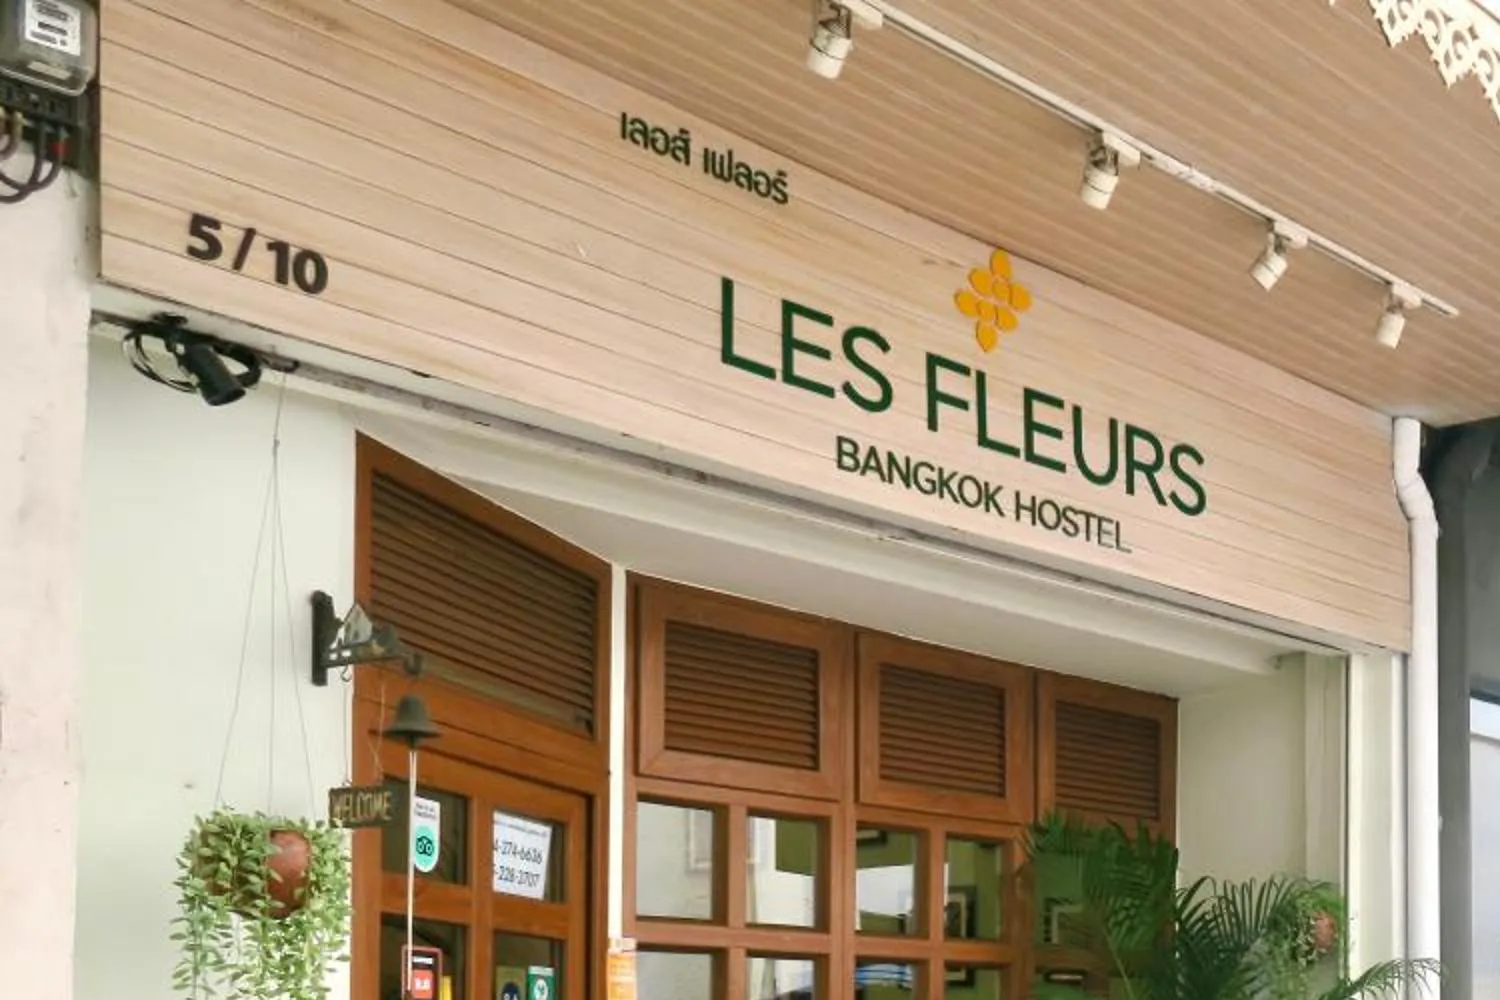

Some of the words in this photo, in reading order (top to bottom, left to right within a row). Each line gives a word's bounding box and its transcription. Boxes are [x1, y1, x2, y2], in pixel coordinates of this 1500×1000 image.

[720, 275, 893, 413] LES
[925, 351, 1208, 516] FLEURS
[835, 435, 1005, 517] BANGKOK
[1014, 490, 1132, 554] HOSTEL
[331, 791, 393, 822] WELCOME
